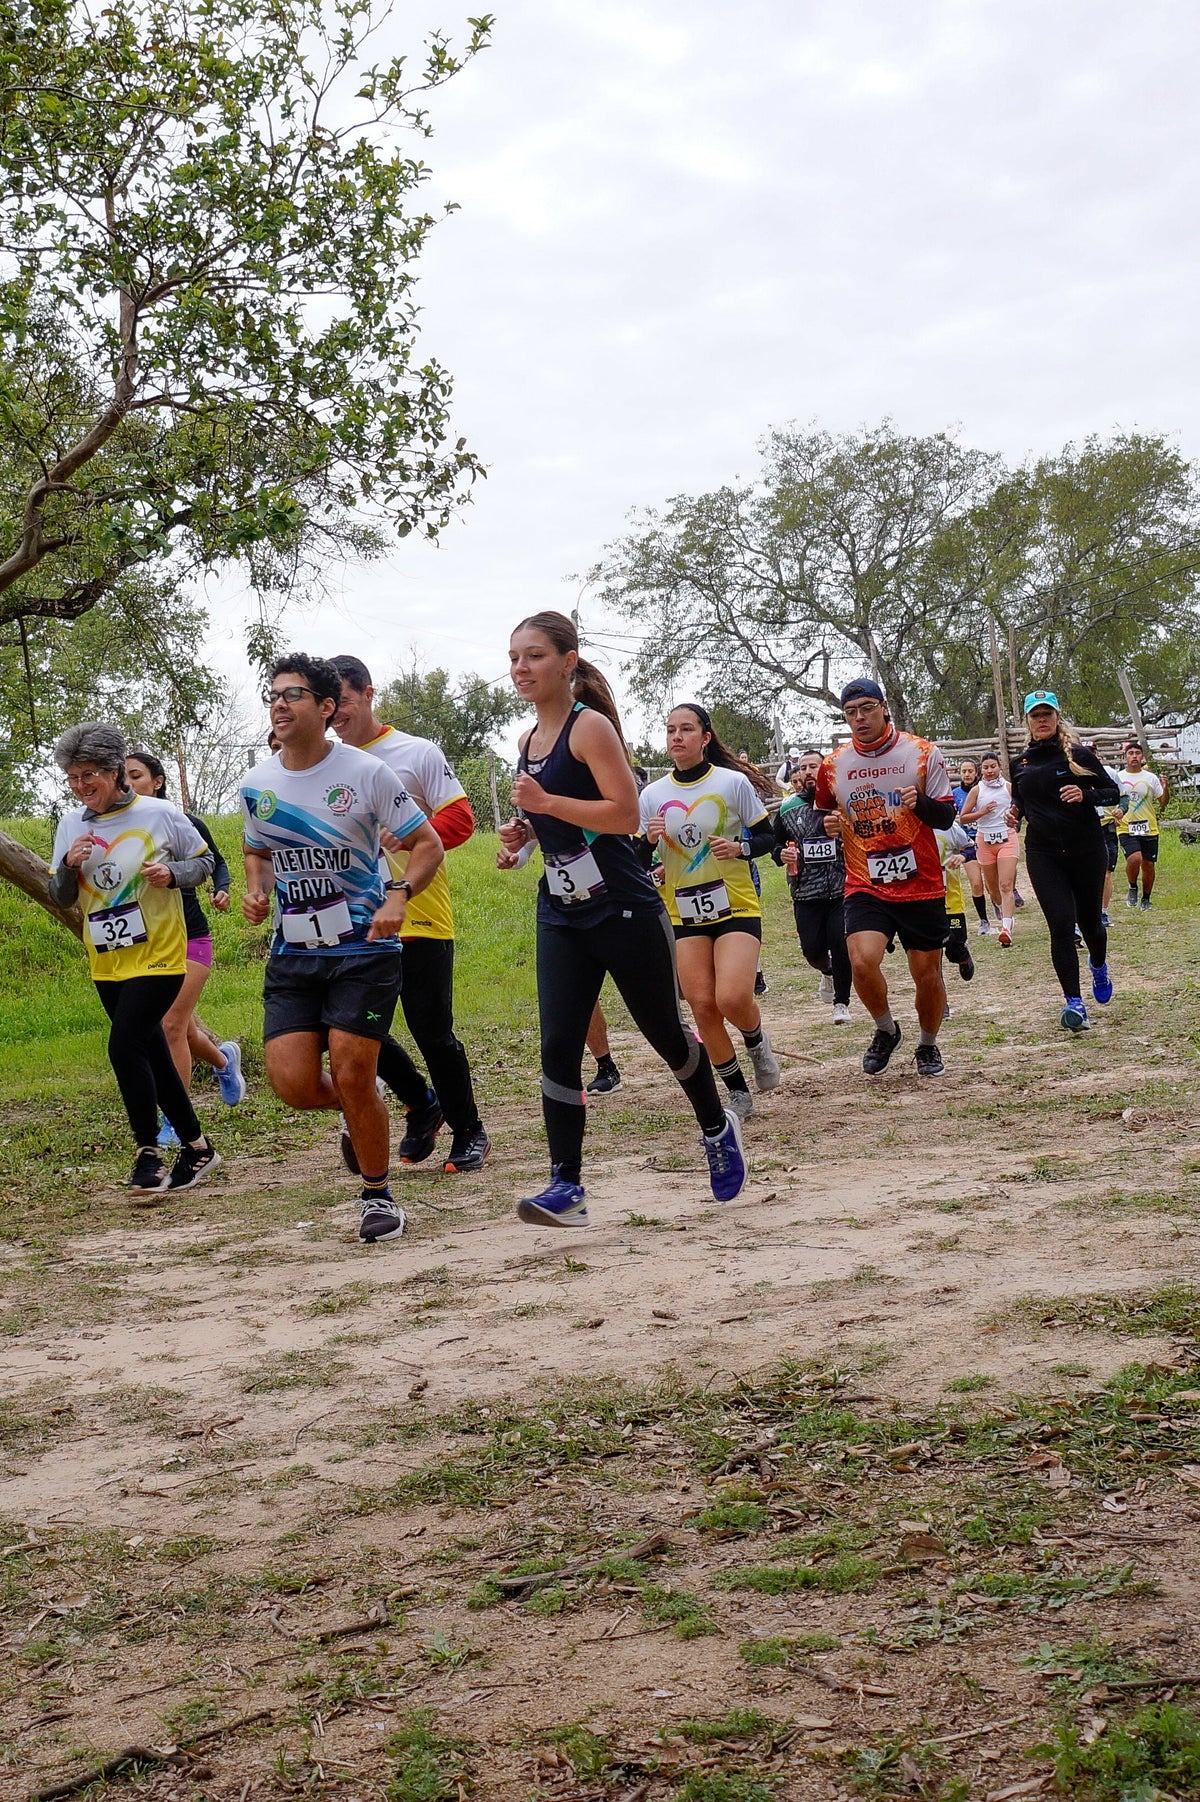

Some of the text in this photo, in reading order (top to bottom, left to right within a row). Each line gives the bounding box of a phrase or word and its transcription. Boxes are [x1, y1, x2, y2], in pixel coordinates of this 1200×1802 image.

[858, 764, 906, 779] Gigared
[850, 788, 878, 801] GOYA
[856, 804, 887, 822] RUN
[1131, 823, 1147, 833] 409
[807, 843, 832, 857] 448
[875, 855, 911, 877] 242
[557, 869, 576, 894] 3
[691, 894, 715, 916] 15
[102, 918, 132, 943] 32
[308, 914, 323, 939] 1
